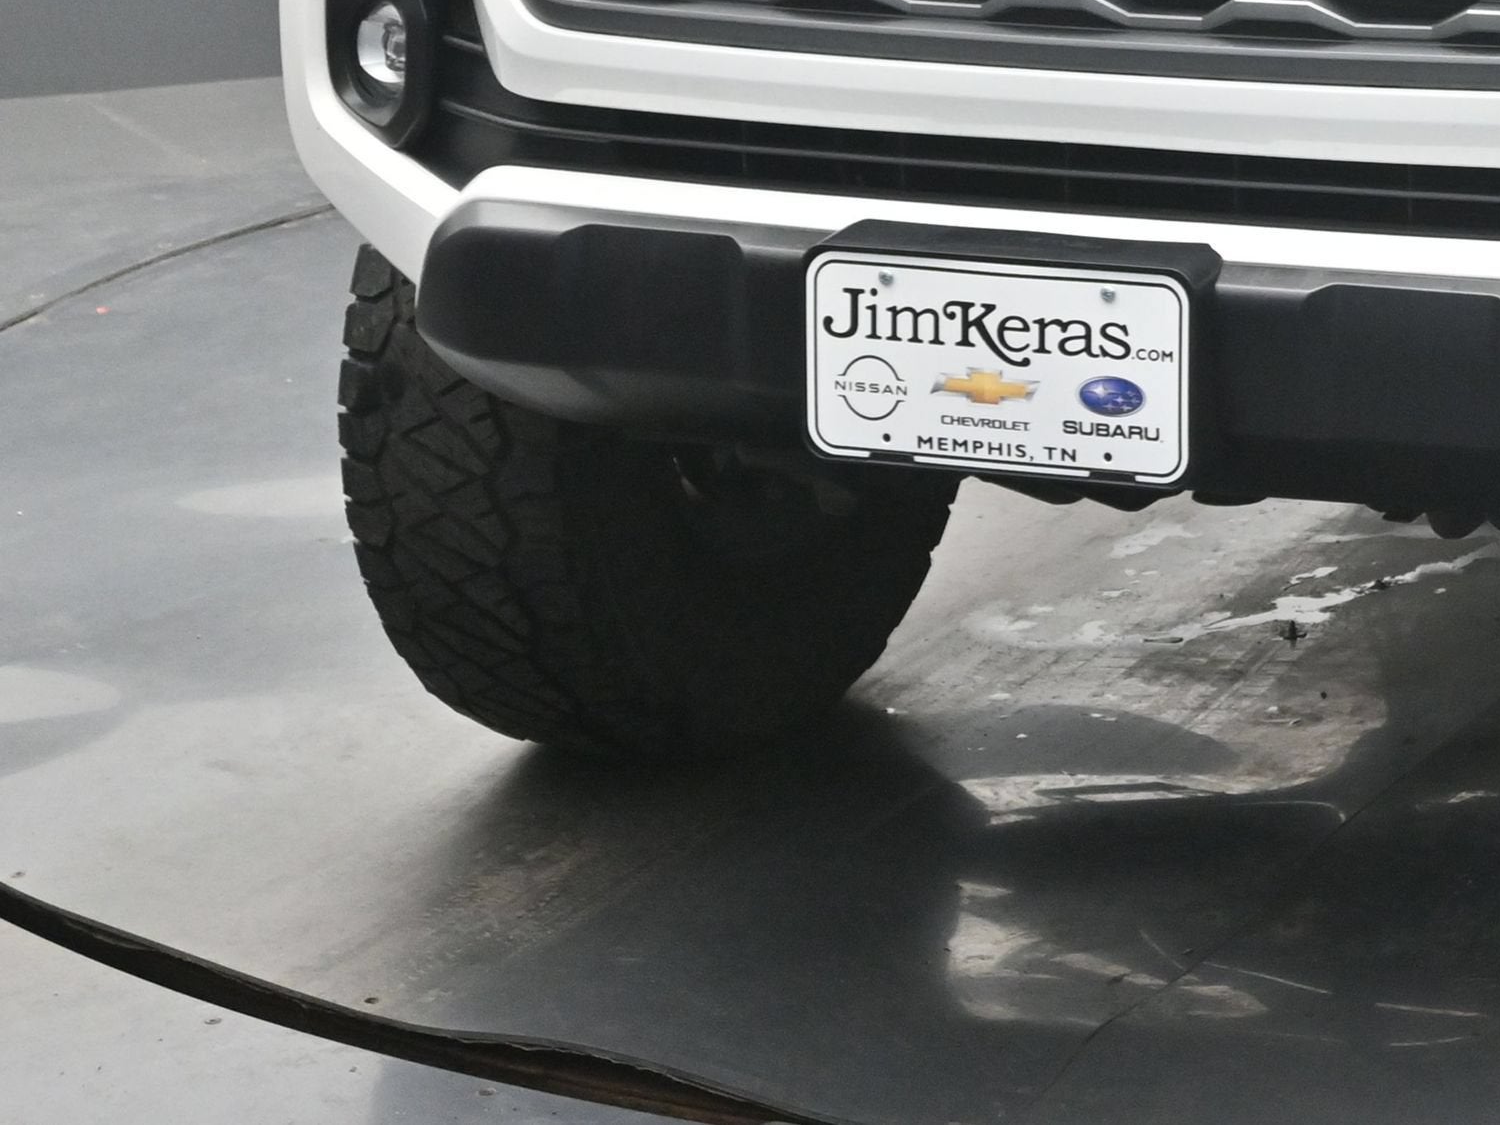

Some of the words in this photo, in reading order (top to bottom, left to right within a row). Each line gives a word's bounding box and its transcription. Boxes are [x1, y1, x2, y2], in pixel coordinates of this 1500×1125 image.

[834, 379, 908, 397] NISSAN
[940, 414, 1030, 432] CHEVROLET
[1062, 419, 1160, 442] SUBARU
[916, 435, 1034, 462] MEMPHIS,
[1043, 446, 1077, 463] TN
